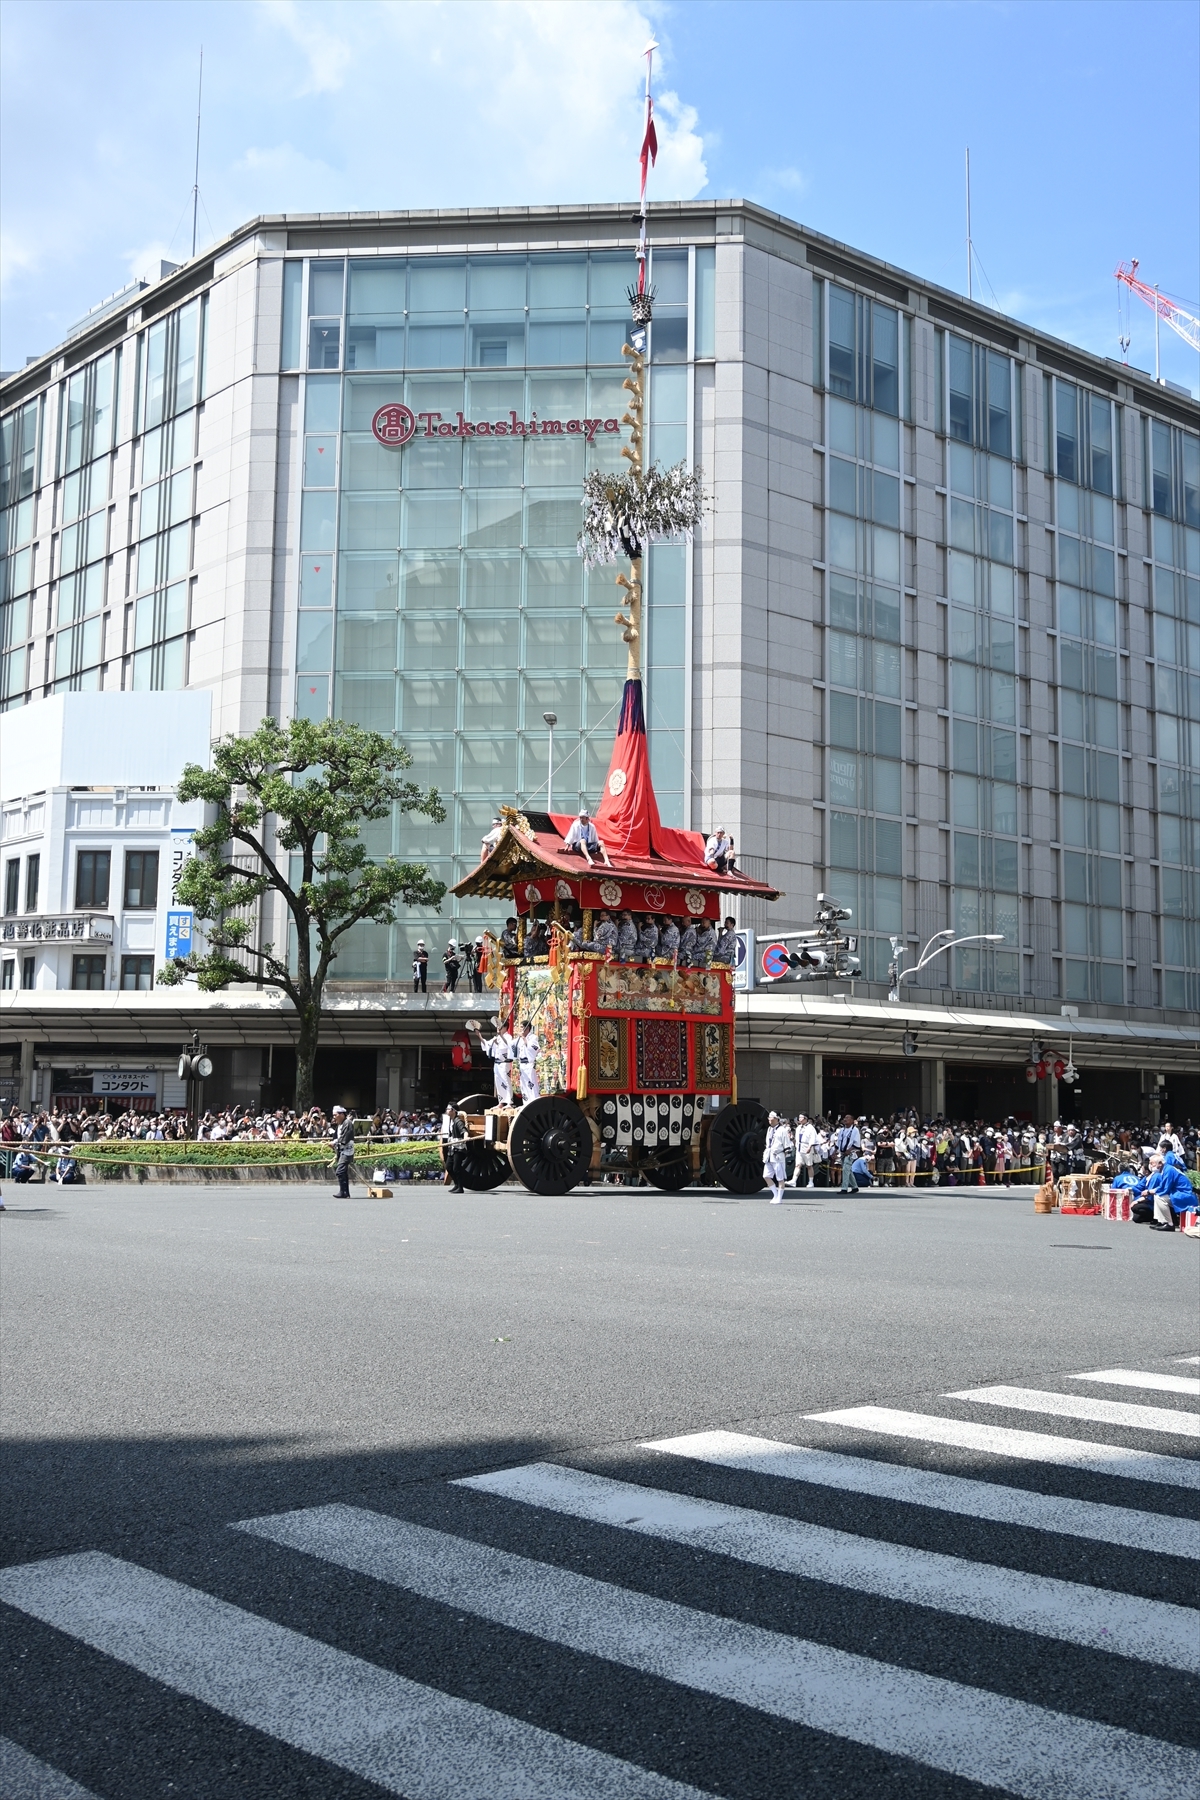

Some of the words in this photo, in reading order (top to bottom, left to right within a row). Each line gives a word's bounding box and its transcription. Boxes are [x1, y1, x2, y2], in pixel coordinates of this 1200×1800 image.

[418, 410, 621, 442] Takashimaya
[168, 915, 179, 957] 買えます
[180, 916, 190, 938] すぐ
[101, 1081, 149, 1091] コンタクト
